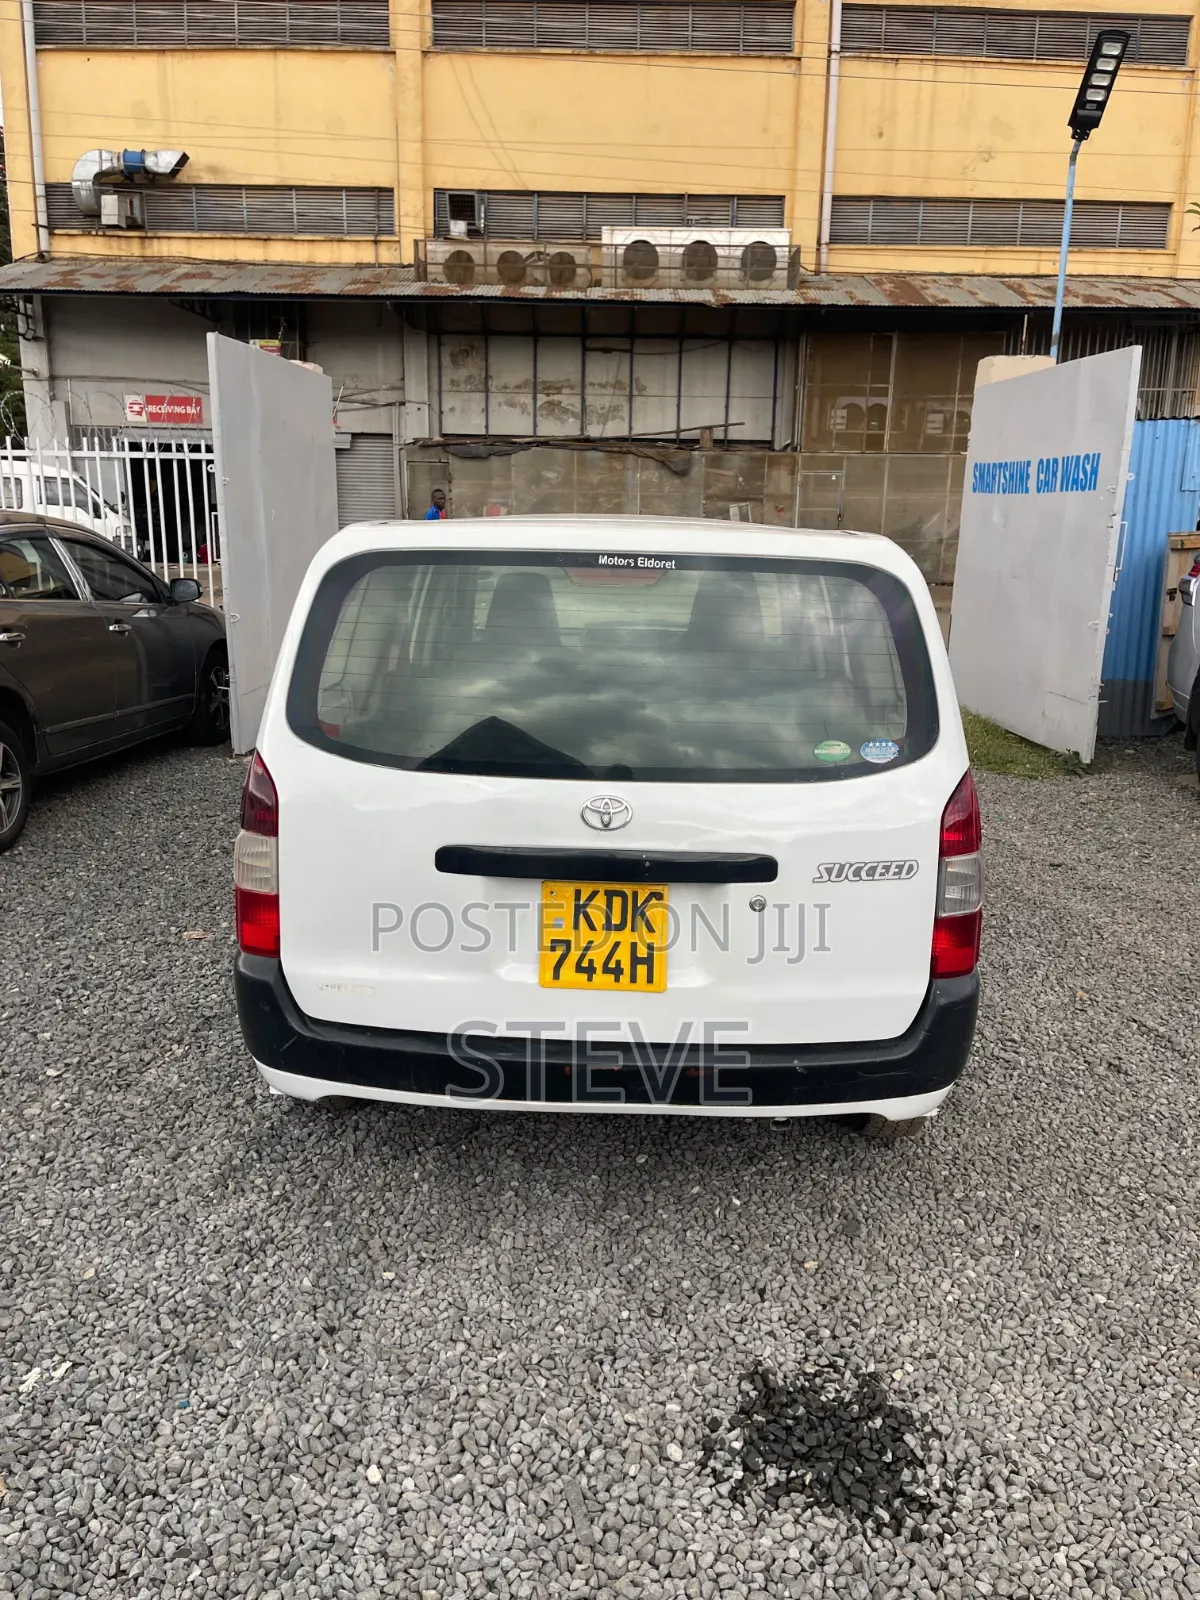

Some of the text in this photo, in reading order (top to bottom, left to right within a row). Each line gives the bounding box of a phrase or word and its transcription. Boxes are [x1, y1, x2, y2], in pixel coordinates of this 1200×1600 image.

[148, 405, 200, 414] RECEIVING BAY
[972, 452, 1101, 494] SMARTSHINE CAR WASH
[598, 554, 676, 569] Motors Eldoret
[812, 859, 919, 883] SUCCEED
[572, 889, 662, 934] KDK
[550, 939, 655, 985] 744H
